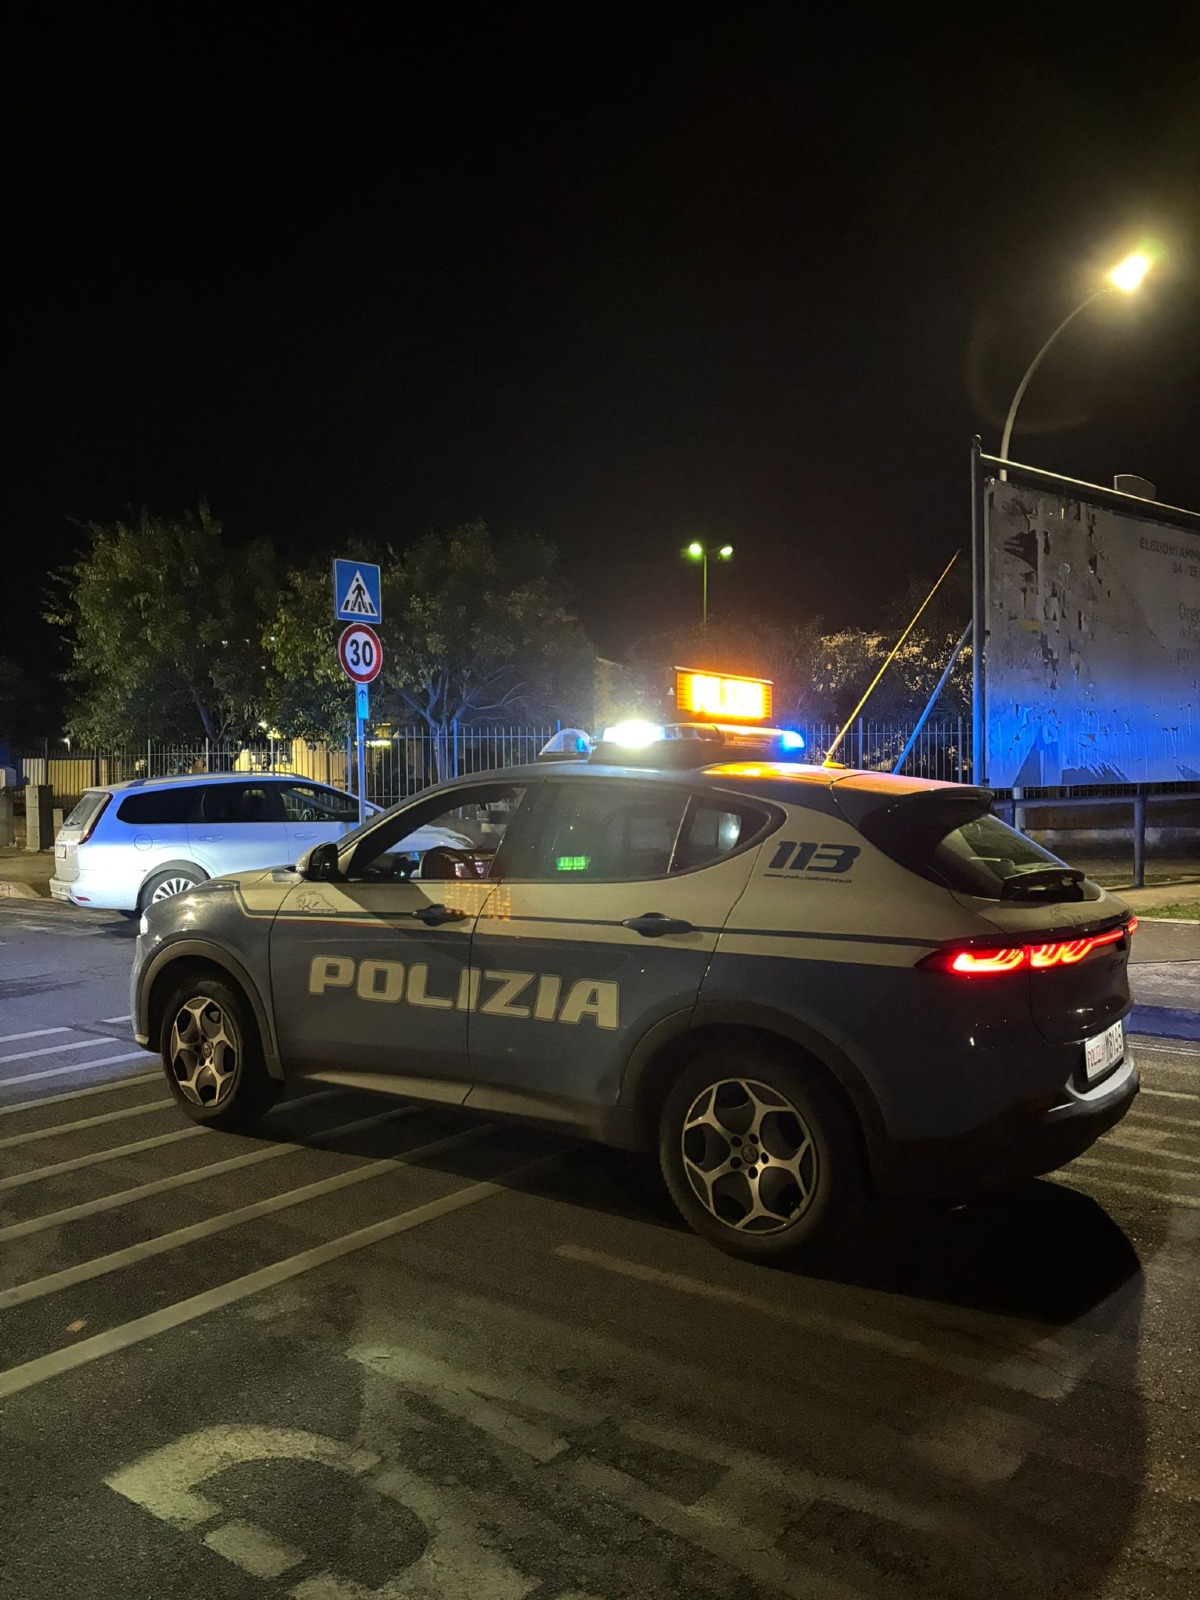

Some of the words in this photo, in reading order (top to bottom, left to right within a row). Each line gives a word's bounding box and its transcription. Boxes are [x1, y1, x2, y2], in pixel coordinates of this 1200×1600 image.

[1139, 536, 1178, 557] ELEZIONI
[1172, 561, 1184, 575] 24
[350, 638, 374, 667] 30
[767, 840, 861, 874] 113
[308, 953, 620, 1030] POLIZIA
